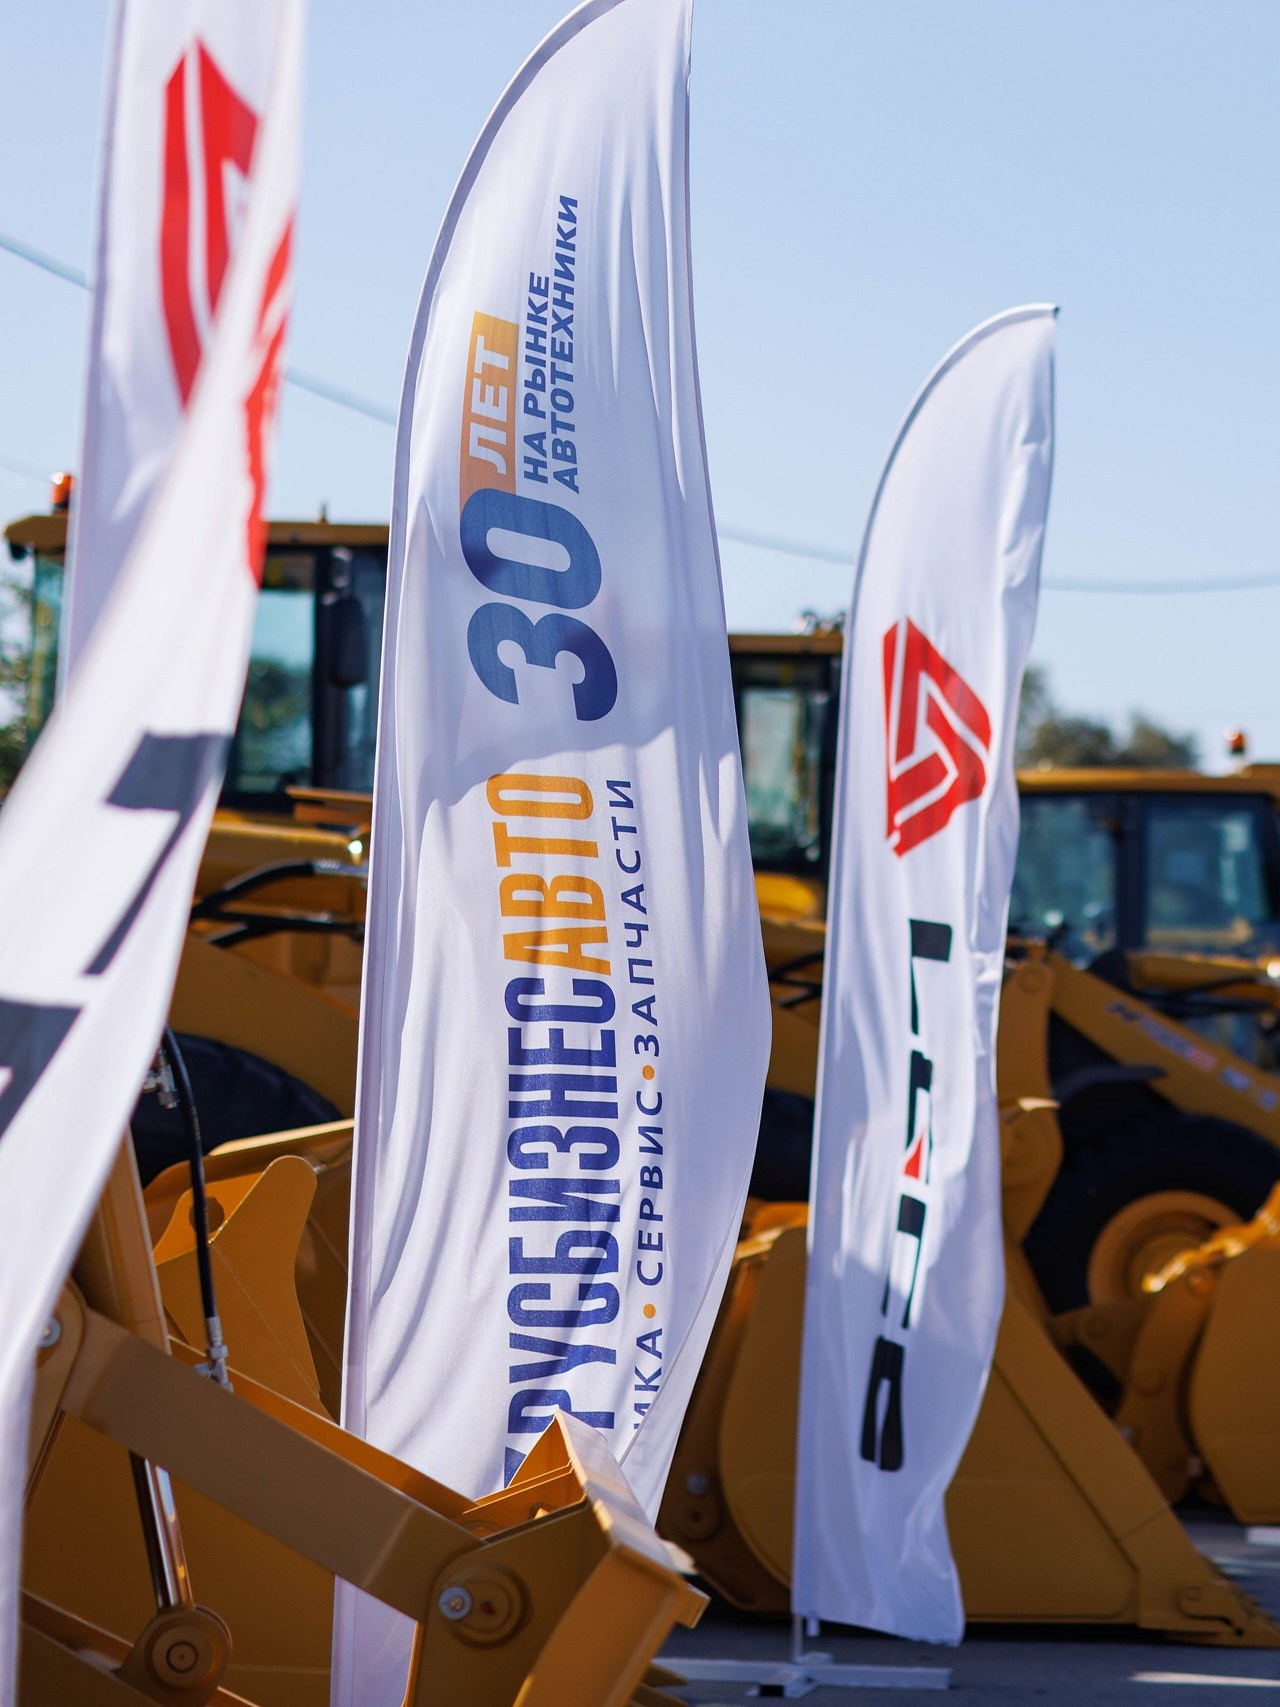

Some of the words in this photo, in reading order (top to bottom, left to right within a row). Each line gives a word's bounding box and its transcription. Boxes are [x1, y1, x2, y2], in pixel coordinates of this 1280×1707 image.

[468, 334, 509, 475] ЛЕТ
[524, 272, 551, 420] РЫНКЕ
[550, 195, 580, 494] АВТОТЕХНИКИ
[524, 431, 549, 484] НА
[459, 486, 618, 722] 30
[606, 779, 660, 1058] ЗАПЧАСТИ
[485, 772, 621, 1434] РУСБИЗНЕСАВТО
[636, 1090, 664, 1287] СЕРВИС
